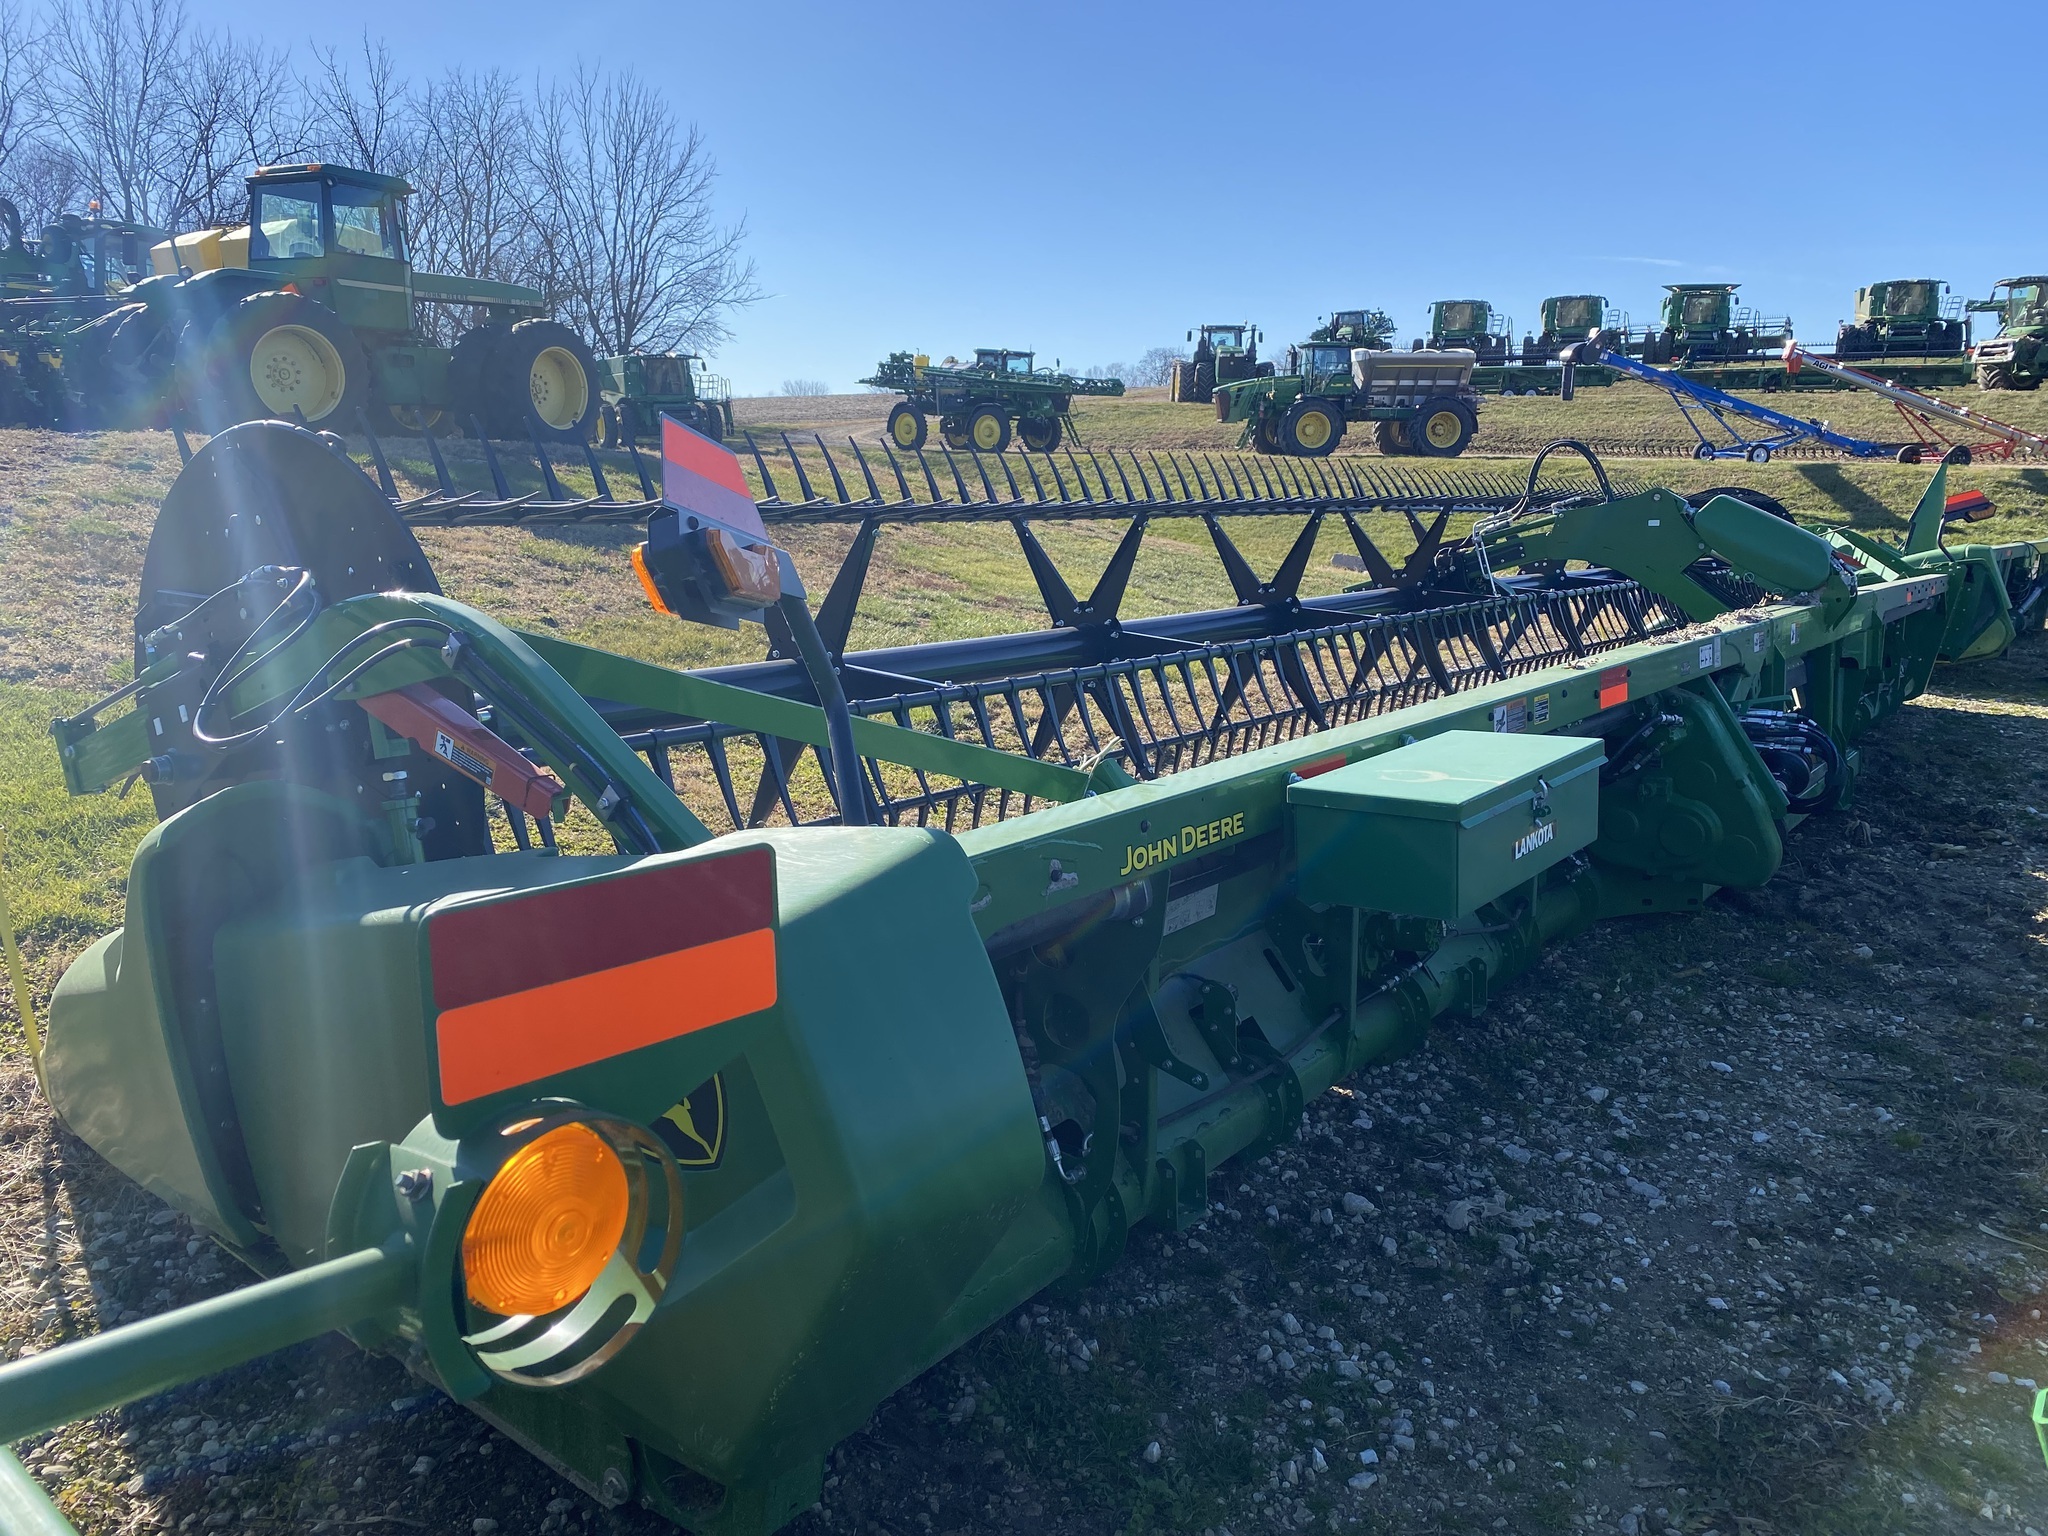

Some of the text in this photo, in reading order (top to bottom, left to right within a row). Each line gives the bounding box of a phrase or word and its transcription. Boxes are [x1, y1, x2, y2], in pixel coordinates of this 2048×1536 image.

[1812, 360, 1829, 370] AGI
[466, 748, 490, 766] WARNING
[1120, 812, 1245, 876] JOHN DEERE
[1515, 822, 1554, 860] LANKOTA
